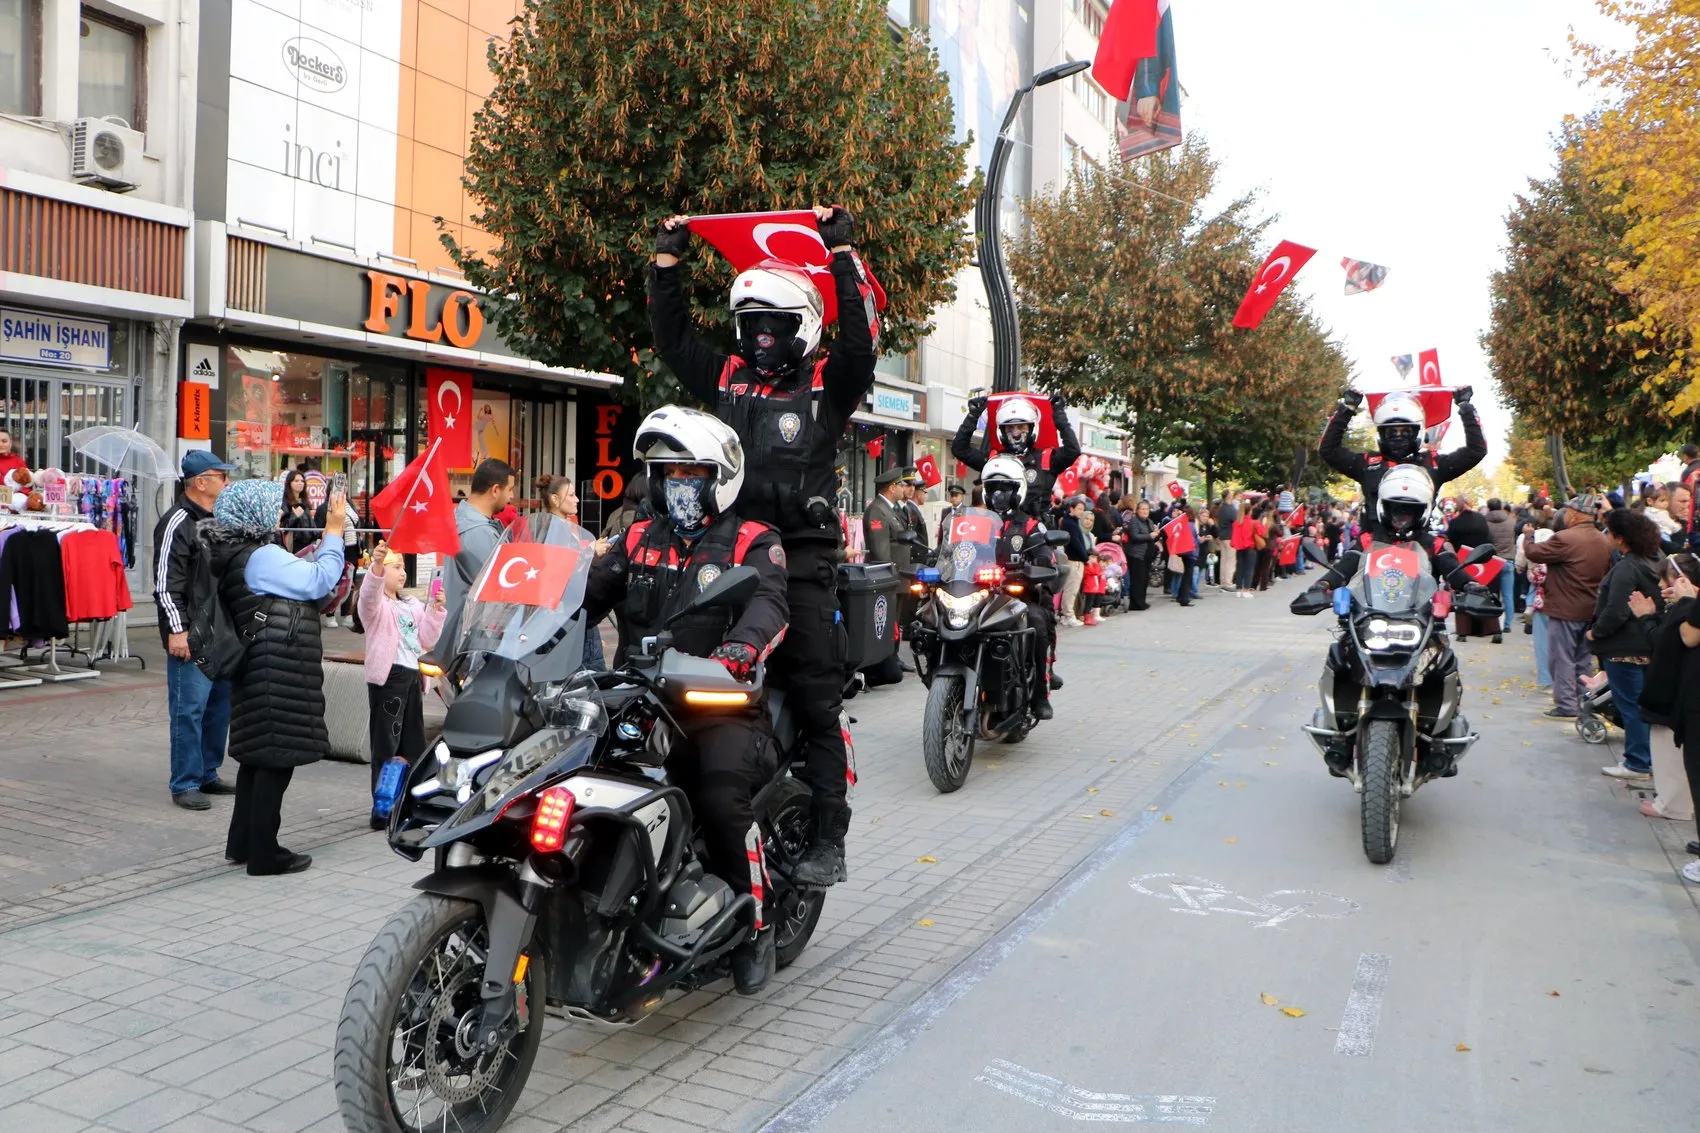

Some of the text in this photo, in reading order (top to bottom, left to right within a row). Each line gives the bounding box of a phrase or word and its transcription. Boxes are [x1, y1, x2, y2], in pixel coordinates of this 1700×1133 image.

[282, 123, 341, 191] inci
[364, 270, 484, 350] FLO
[3, 318, 105, 349] ŞAHİN İŞHANI
[41, 350, 71, 360] No: 20
[193, 369, 216, 377] adidas
[193, 388, 201, 422] kinetix
[877, 394, 909, 412] SIEMENS
[592, 404, 624, 500] FLO
